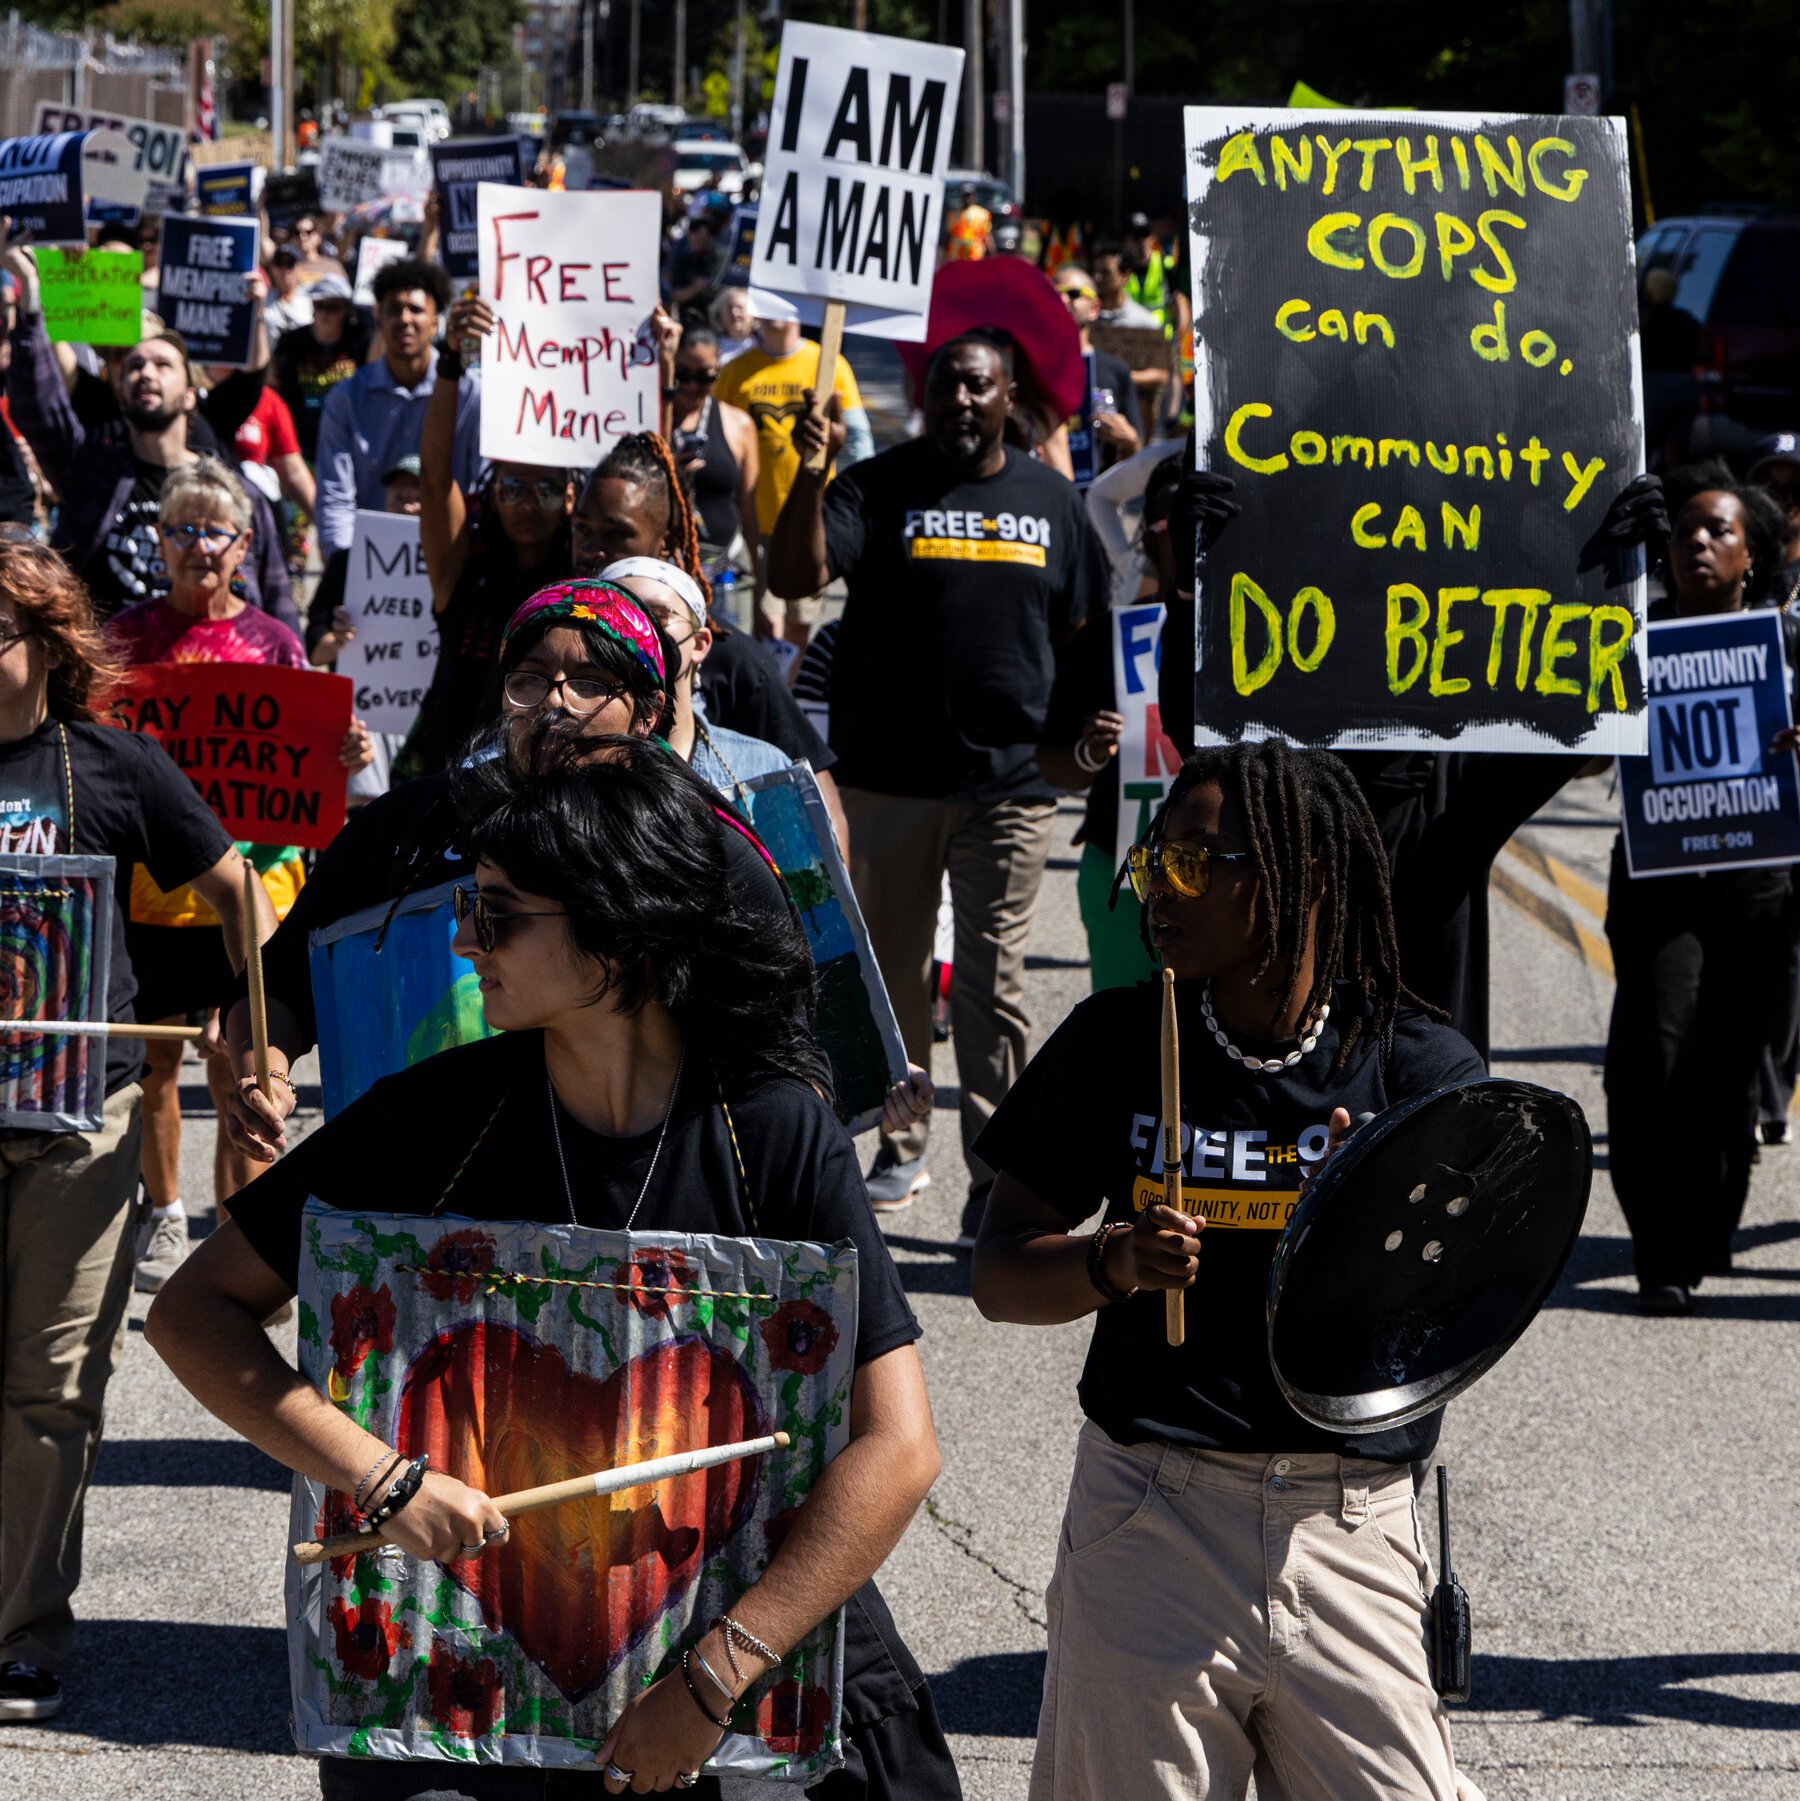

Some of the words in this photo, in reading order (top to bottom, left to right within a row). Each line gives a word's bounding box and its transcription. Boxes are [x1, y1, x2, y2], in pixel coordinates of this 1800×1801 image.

[780, 57, 809, 152] I
[823, 66, 947, 175] AM
[1214, 131, 1589, 202] ANYTHING
[187, 233, 235, 269] FREE
[765, 171, 798, 265] A
[814, 176, 930, 286] MAN
[1307, 209, 1527, 293] COPS
[490, 211, 635, 304] FREE
[161, 264, 250, 305] MEMPHIS
[175, 300, 233, 337] MANE
[1275, 298, 1395, 348] can
[1470, 300, 1574, 376] do.
[496, 317, 656, 396] Memphis
[1223, 402, 1606, 513] Community
[904, 509, 985, 539] FREE
[996, 512, 1051, 548] 901
[1351, 501, 1482, 551] CAN
[363, 595, 423, 620] NEED
[364, 641, 403, 665] WE
[1230, 571, 1336, 696] DO
[1385, 582, 1634, 713] BETTER
[1648, 644, 1767, 692] PORTUNITY
[110, 694, 191, 731] SAY
[215, 693, 281, 730] NO
[1658, 697, 1741, 773] NOT
[161, 737, 310, 778] ILITARY
[1642, 775, 1780, 825] OCCUPATION
[1682, 832, 1720, 853] FREE
[1723, 830, 1753, 848] 901
[1130, 1113, 1268, 1181] FREE
[1265, 1144, 1297, 1164] THE
[1139, 1189, 1241, 1222] OPPTUNITY,
[1246, 1201, 1281, 1221] NOT
